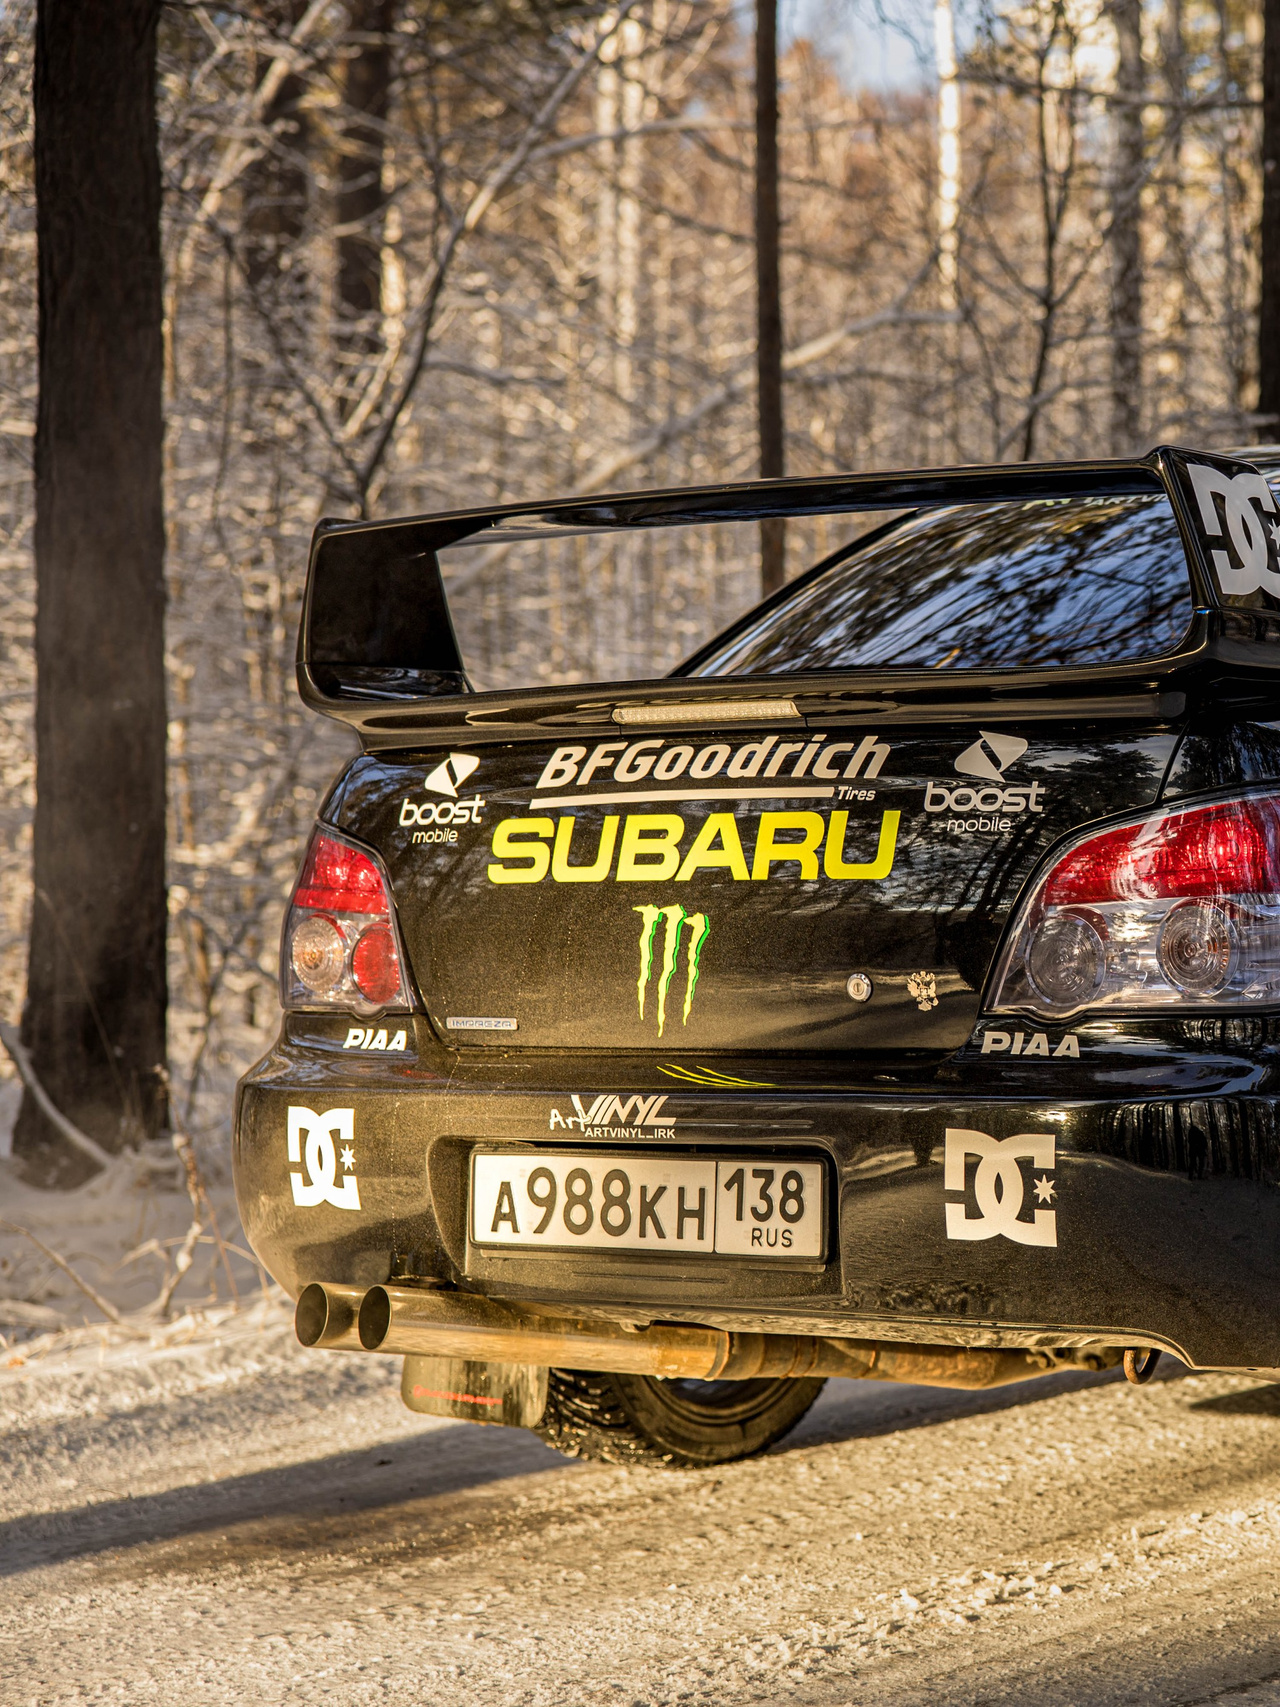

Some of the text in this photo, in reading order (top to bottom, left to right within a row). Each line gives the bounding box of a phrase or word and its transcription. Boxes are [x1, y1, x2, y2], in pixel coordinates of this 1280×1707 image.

[536, 735, 891, 788] BFGoodrich
[837, 785, 876, 801] Tires
[924, 781, 1046, 812] boost
[399, 794, 486, 826] boost
[412, 828, 459, 843] mobile
[947, 817, 1012, 831] mobile
[487, 810, 900, 883] SUBARU
[343, 1028, 407, 1051] PIAA
[981, 1031, 1080, 1058] PIAA
[585, 1127, 675, 1139] ARTVINYL_IRK
[724, 1168, 805, 1223] 138
[751, 1227, 793, 1248] RUS
